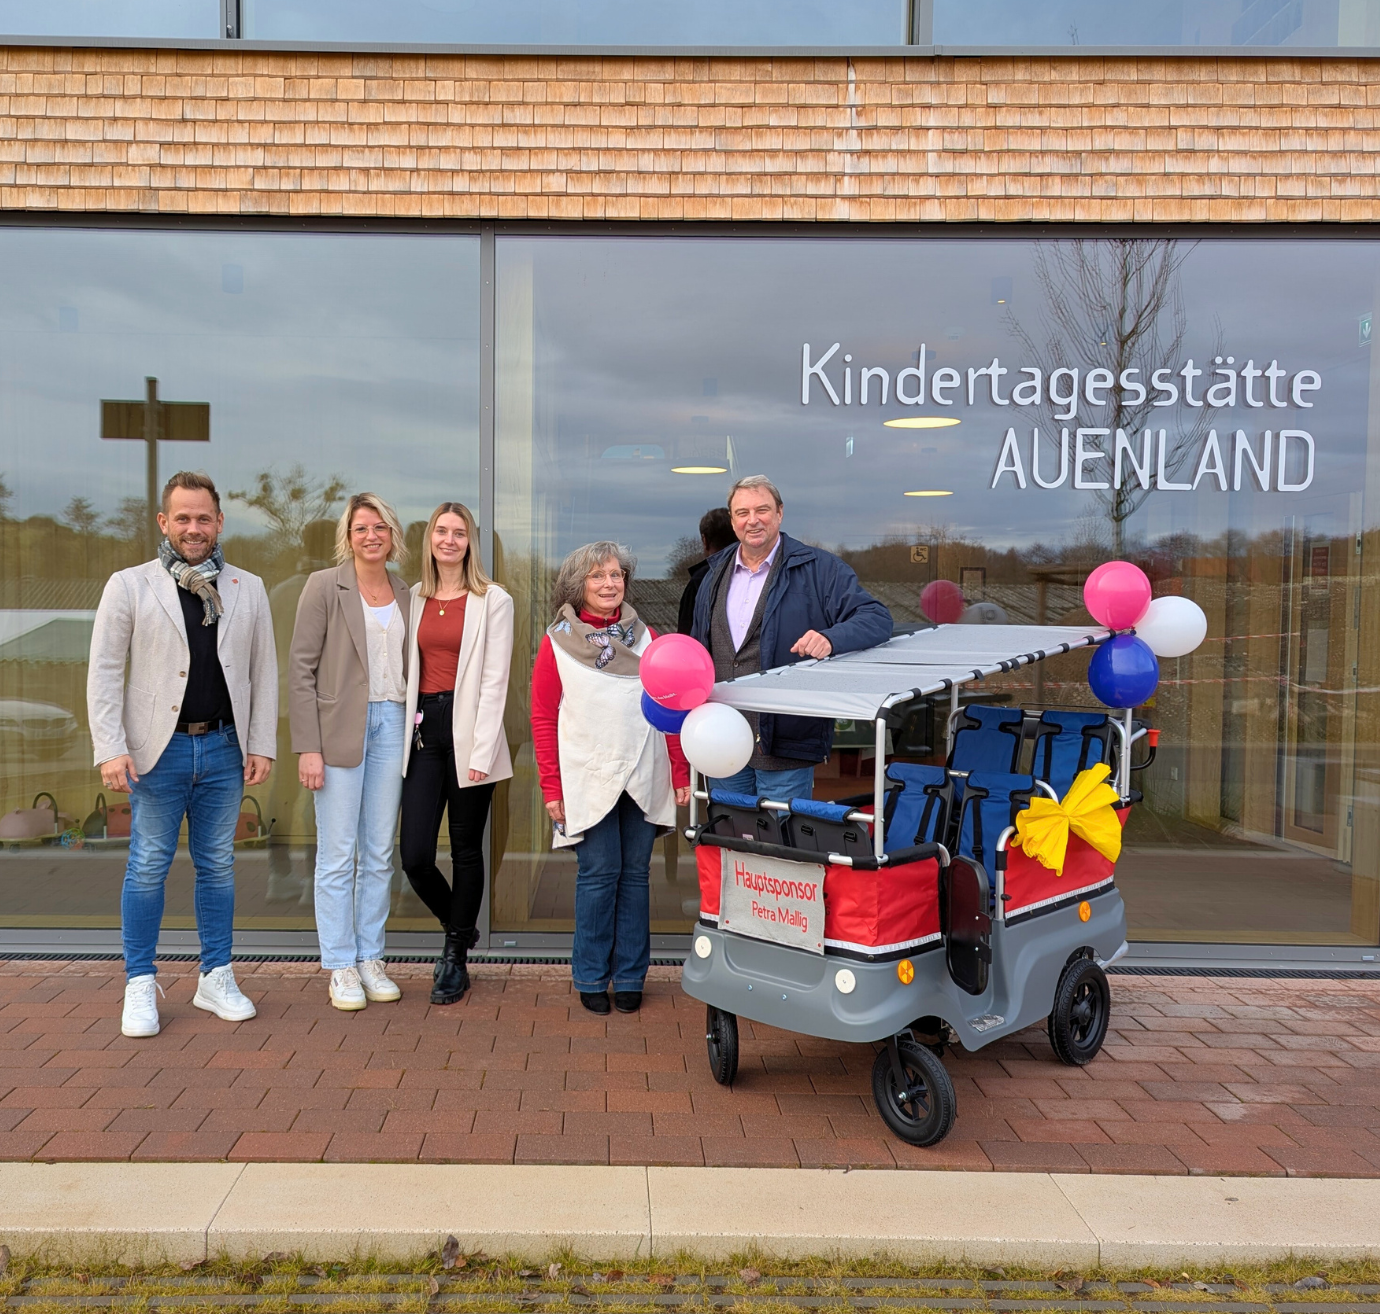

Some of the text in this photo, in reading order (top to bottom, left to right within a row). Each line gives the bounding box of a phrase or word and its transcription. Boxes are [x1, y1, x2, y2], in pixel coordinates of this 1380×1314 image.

[801, 342, 1322, 421] Kindertagesstätte
[991, 427, 1316, 493] AUENLAND
[734, 860, 817, 901] Hauptsponsor
[751, 901, 776, 922] Petra
[778, 907, 808, 933] Mallig
